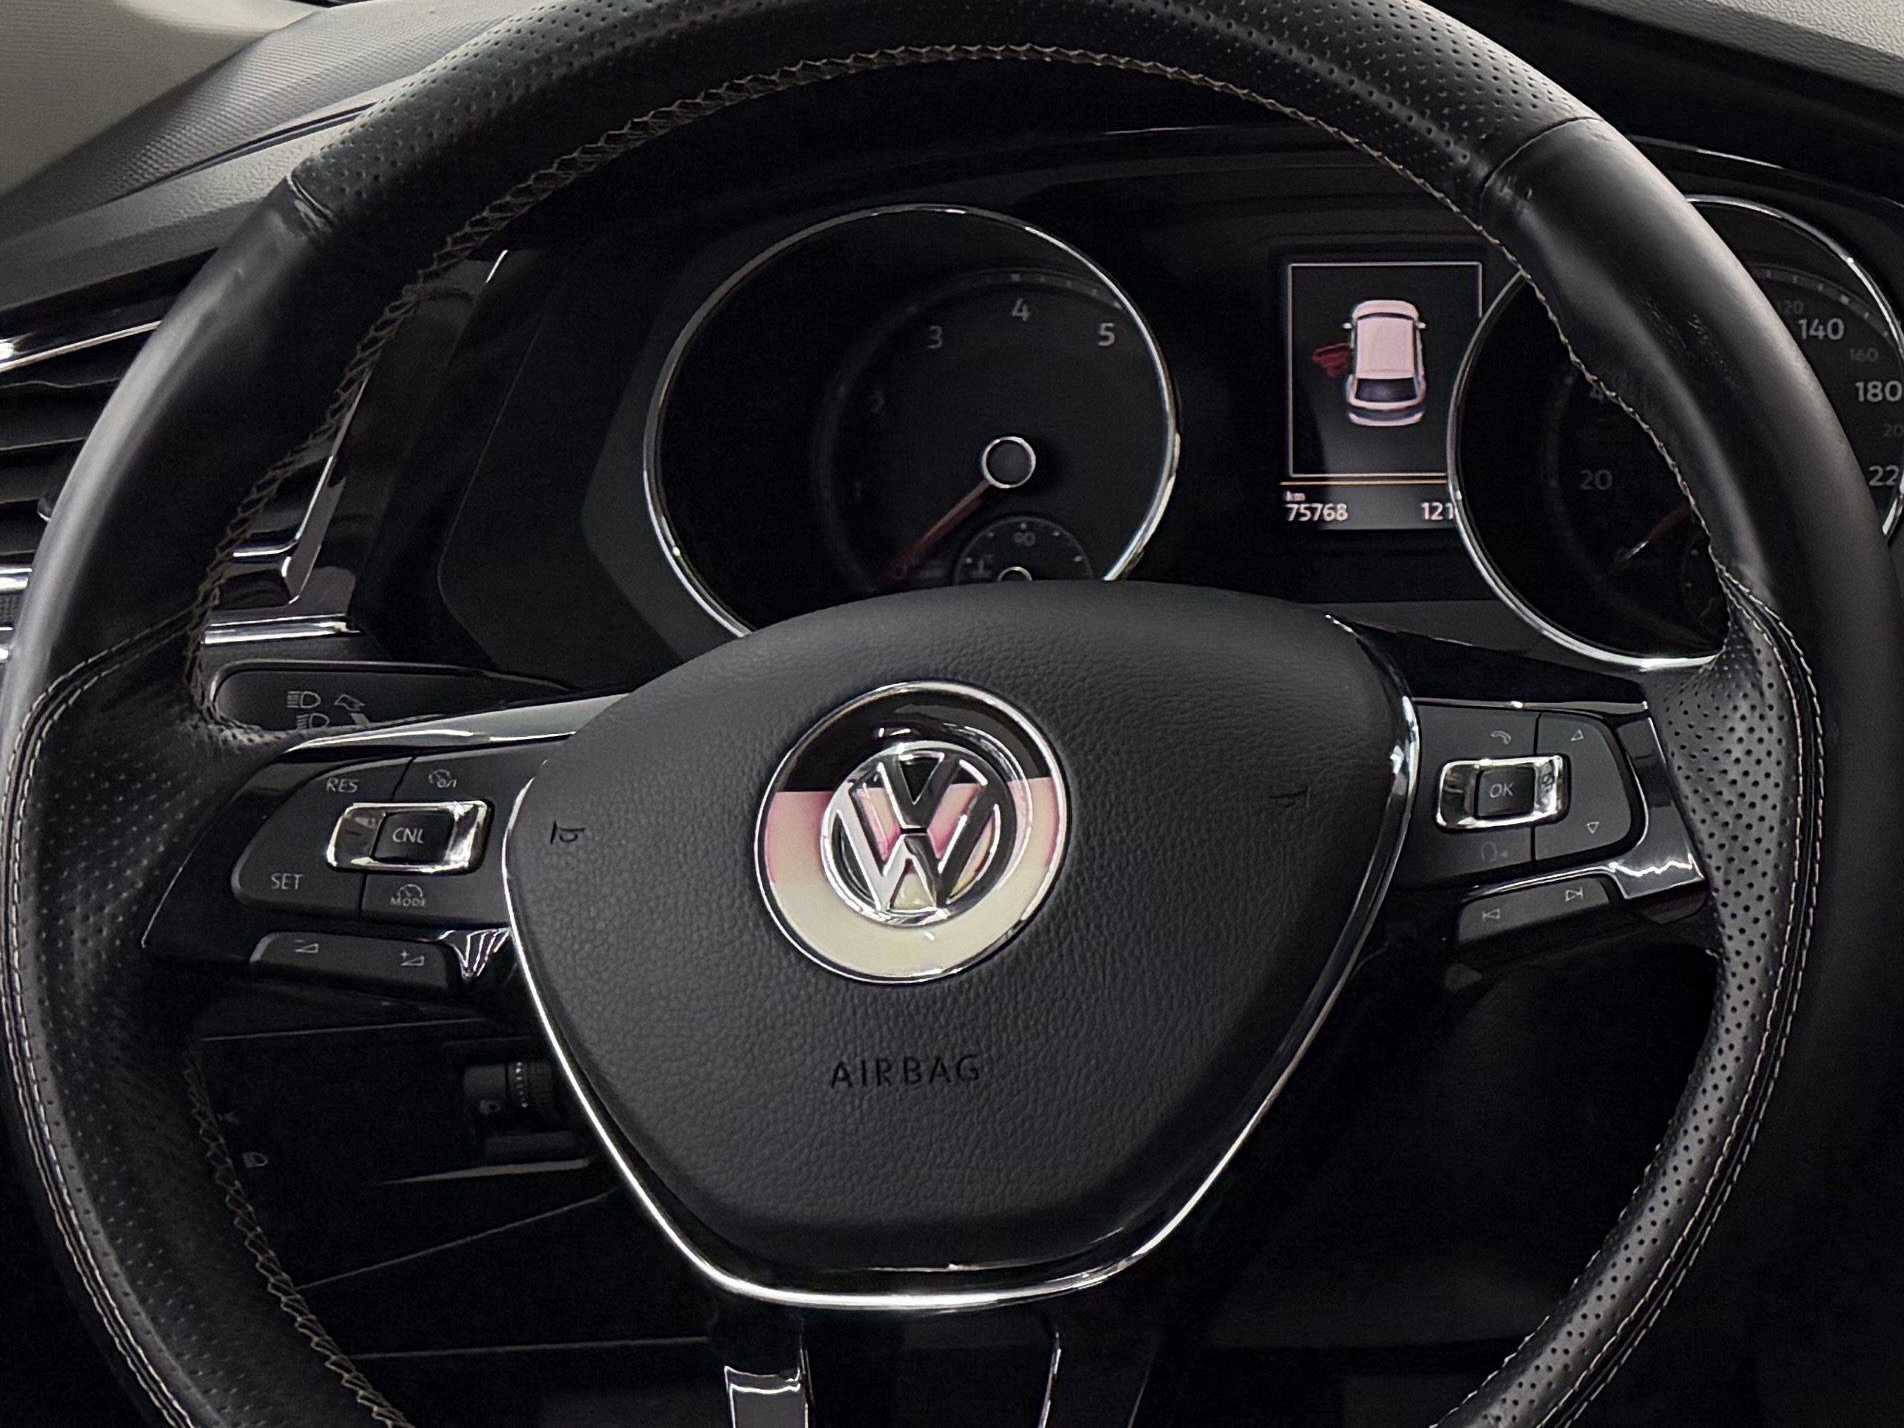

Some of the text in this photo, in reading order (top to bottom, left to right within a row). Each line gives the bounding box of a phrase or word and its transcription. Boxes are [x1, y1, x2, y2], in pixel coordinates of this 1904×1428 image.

[1012, 298, 1030, 322] 4
[927, 325, 944, 350] 3
[1098, 323, 1115, 347] 5
[1798, 318, 1845, 341] 140
[1849, 347, 1879, 363] 160
[1855, 380, 1903, 403] 180
[1579, 469, 1614, 491] 20
[1285, 503, 1349, 522] 75768
[325, 778, 360, 793] RES
[1489, 783, 1514, 799] OK
[392, 826, 425, 844] CNL
[270, 873, 303, 890] SET
[830, 1055, 980, 1089] AIRBAG
